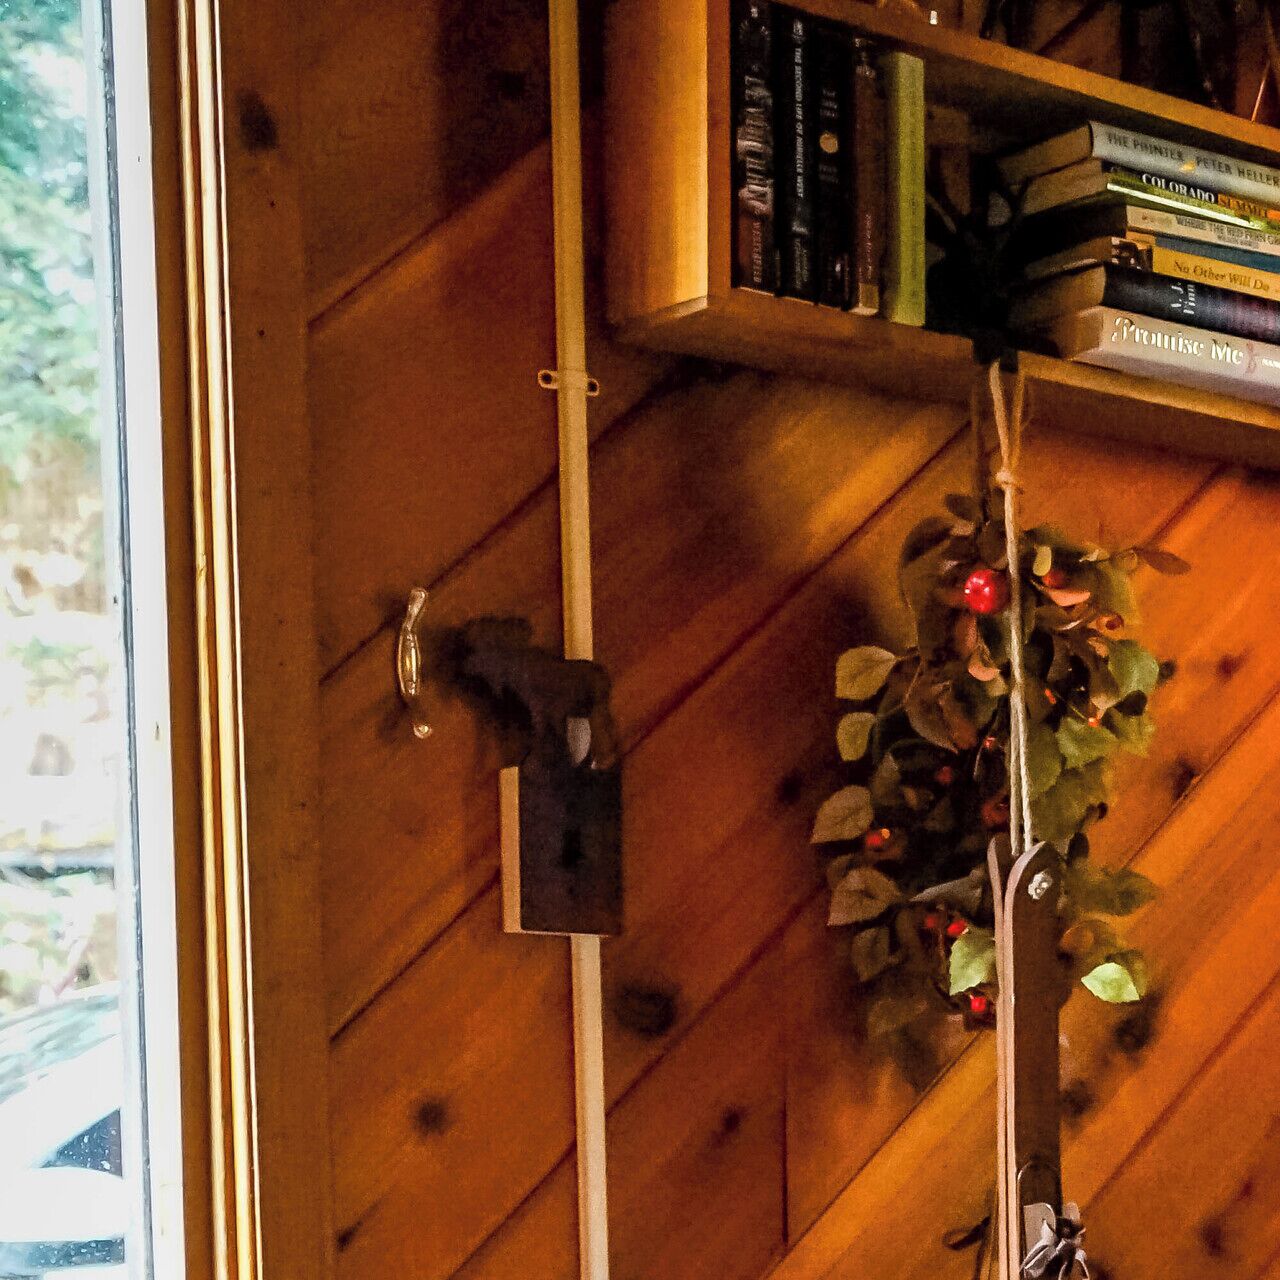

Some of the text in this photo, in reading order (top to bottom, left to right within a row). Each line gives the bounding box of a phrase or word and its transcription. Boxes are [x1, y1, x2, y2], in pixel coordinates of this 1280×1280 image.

[794, 48, 802, 63] THE
[794, 65, 803, 101] SECOND
[795, 103, 803, 120] LIFE
[796, 121, 803, 135] OF
[1107, 132, 1128, 149] THE
[1197, 156, 1279, 187] PETER HELLER
[796, 175, 804, 198] WEST
[1142, 173, 1215, 204] COLORADO
[1209, 221, 1225, 236] THE
[1174, 260, 1270, 293] No Other Will Do
[1111, 316, 1244, 365] Promise Me
